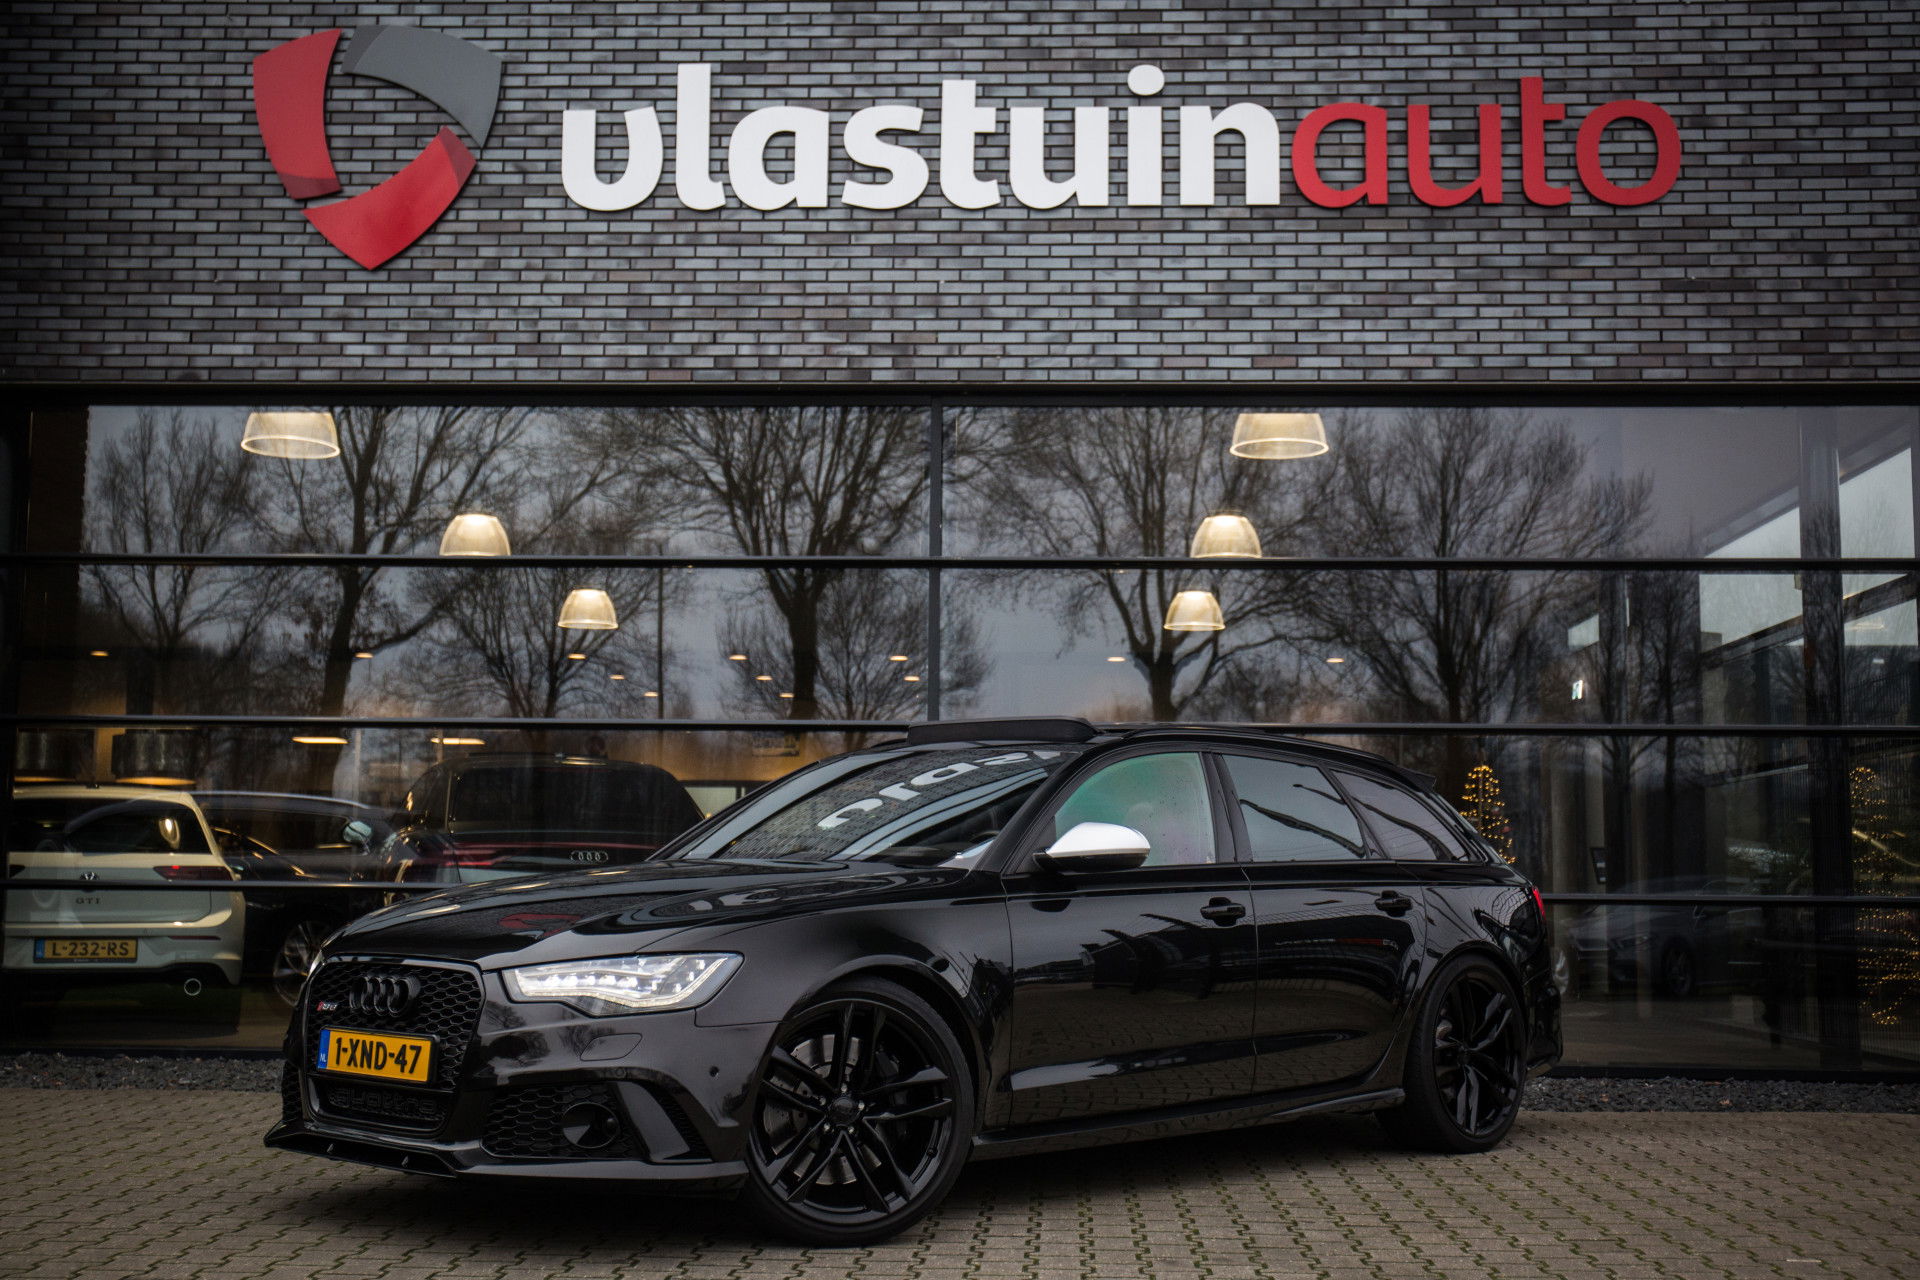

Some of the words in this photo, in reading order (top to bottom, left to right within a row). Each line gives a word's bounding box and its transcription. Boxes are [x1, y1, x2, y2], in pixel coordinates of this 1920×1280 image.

[52, 942, 129, 957] L-232-RS
[319, 1053, 327, 1063] NL
[335, 1037, 422, 1074] 1-XND-47
